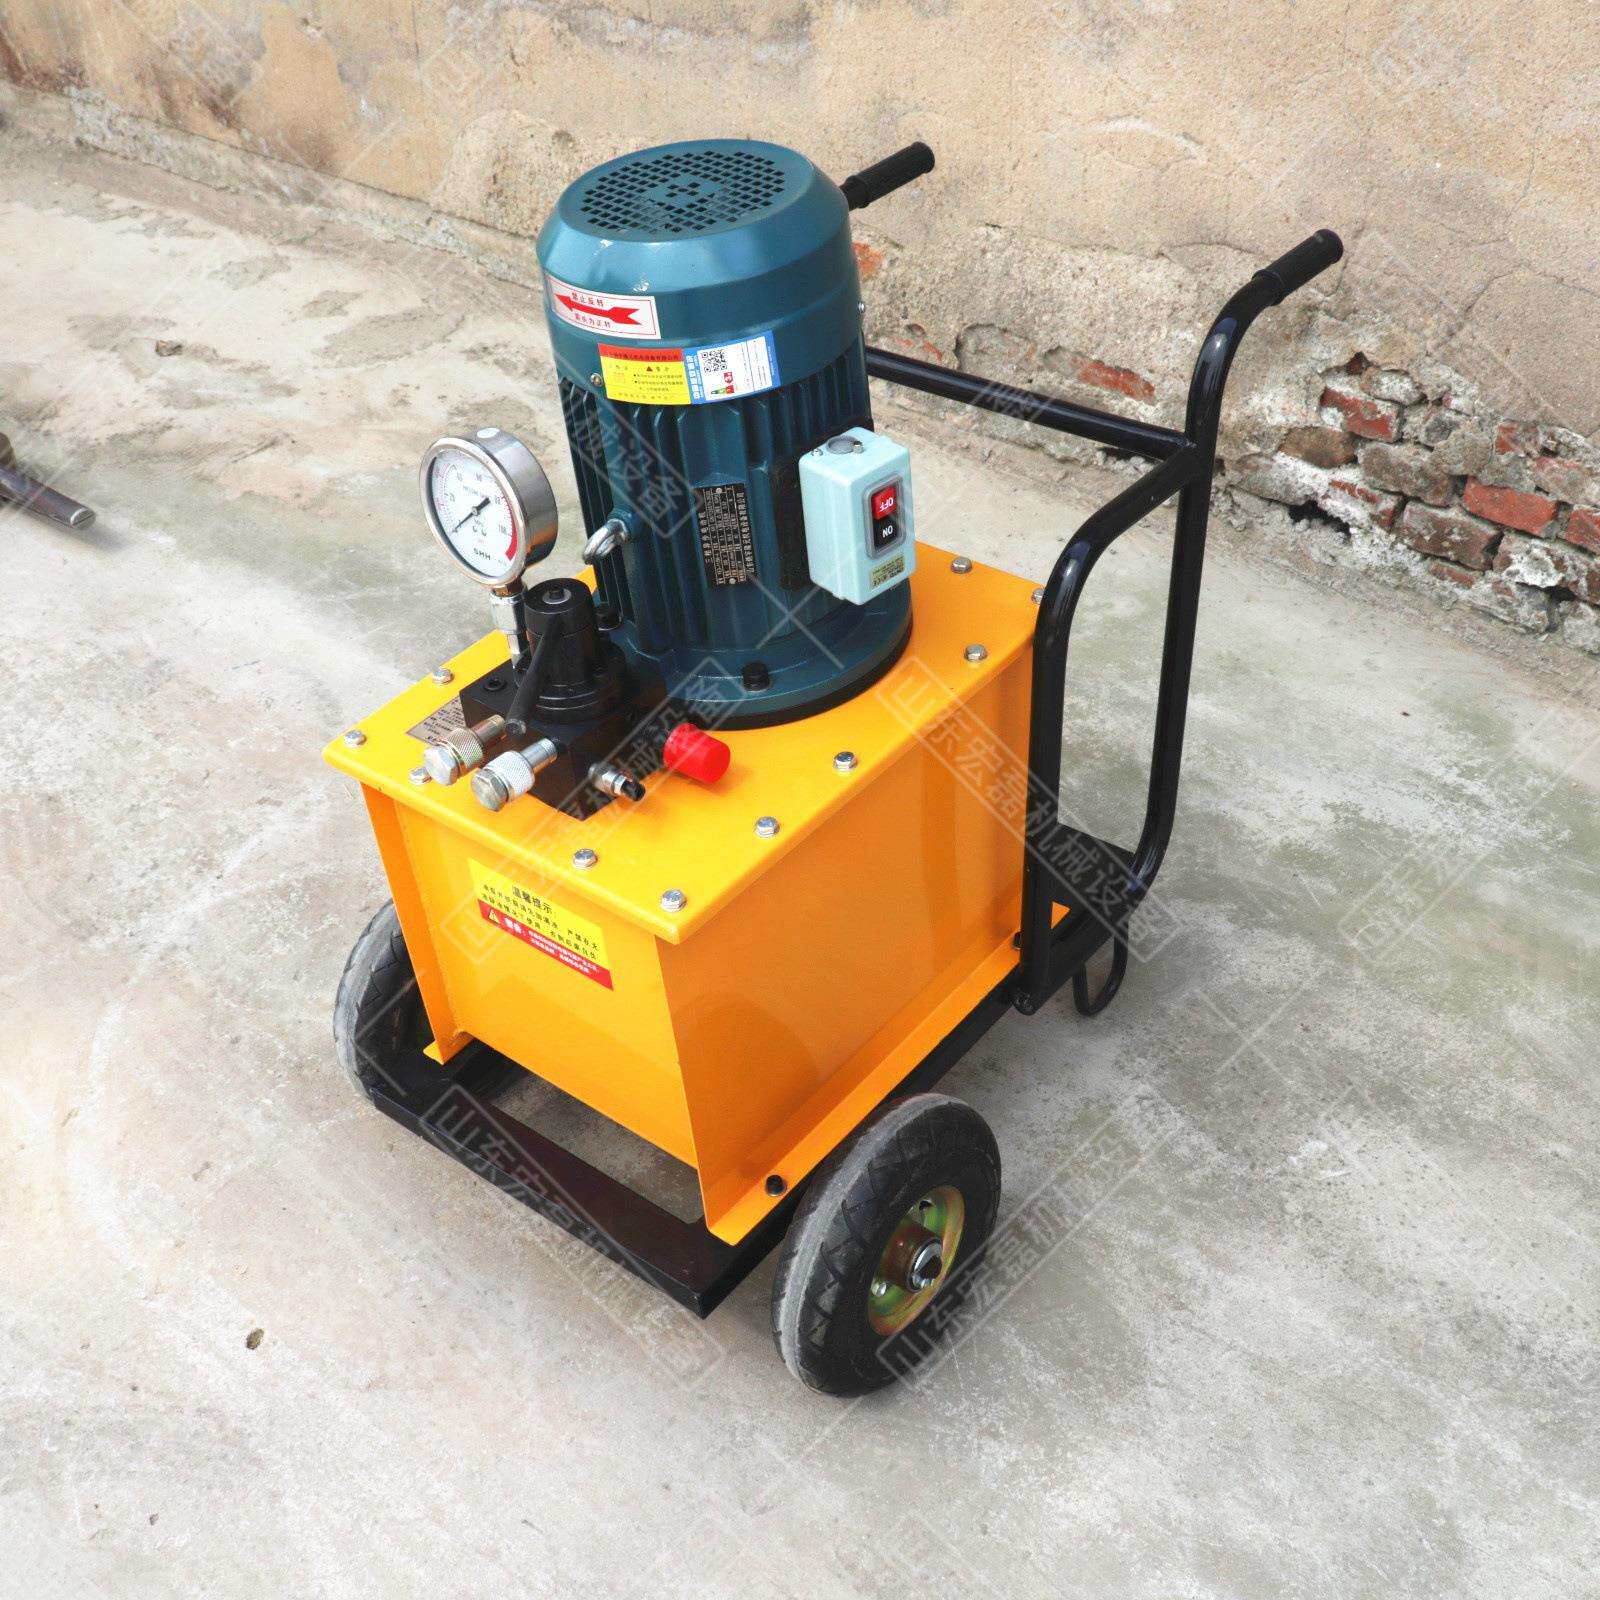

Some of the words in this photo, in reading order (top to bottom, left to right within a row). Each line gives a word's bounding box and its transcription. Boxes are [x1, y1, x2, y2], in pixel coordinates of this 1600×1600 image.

[571, 291, 604, 307] 禁止反转
[879, 497, 894, 512] OFF
[882, 525, 893, 538] ON
